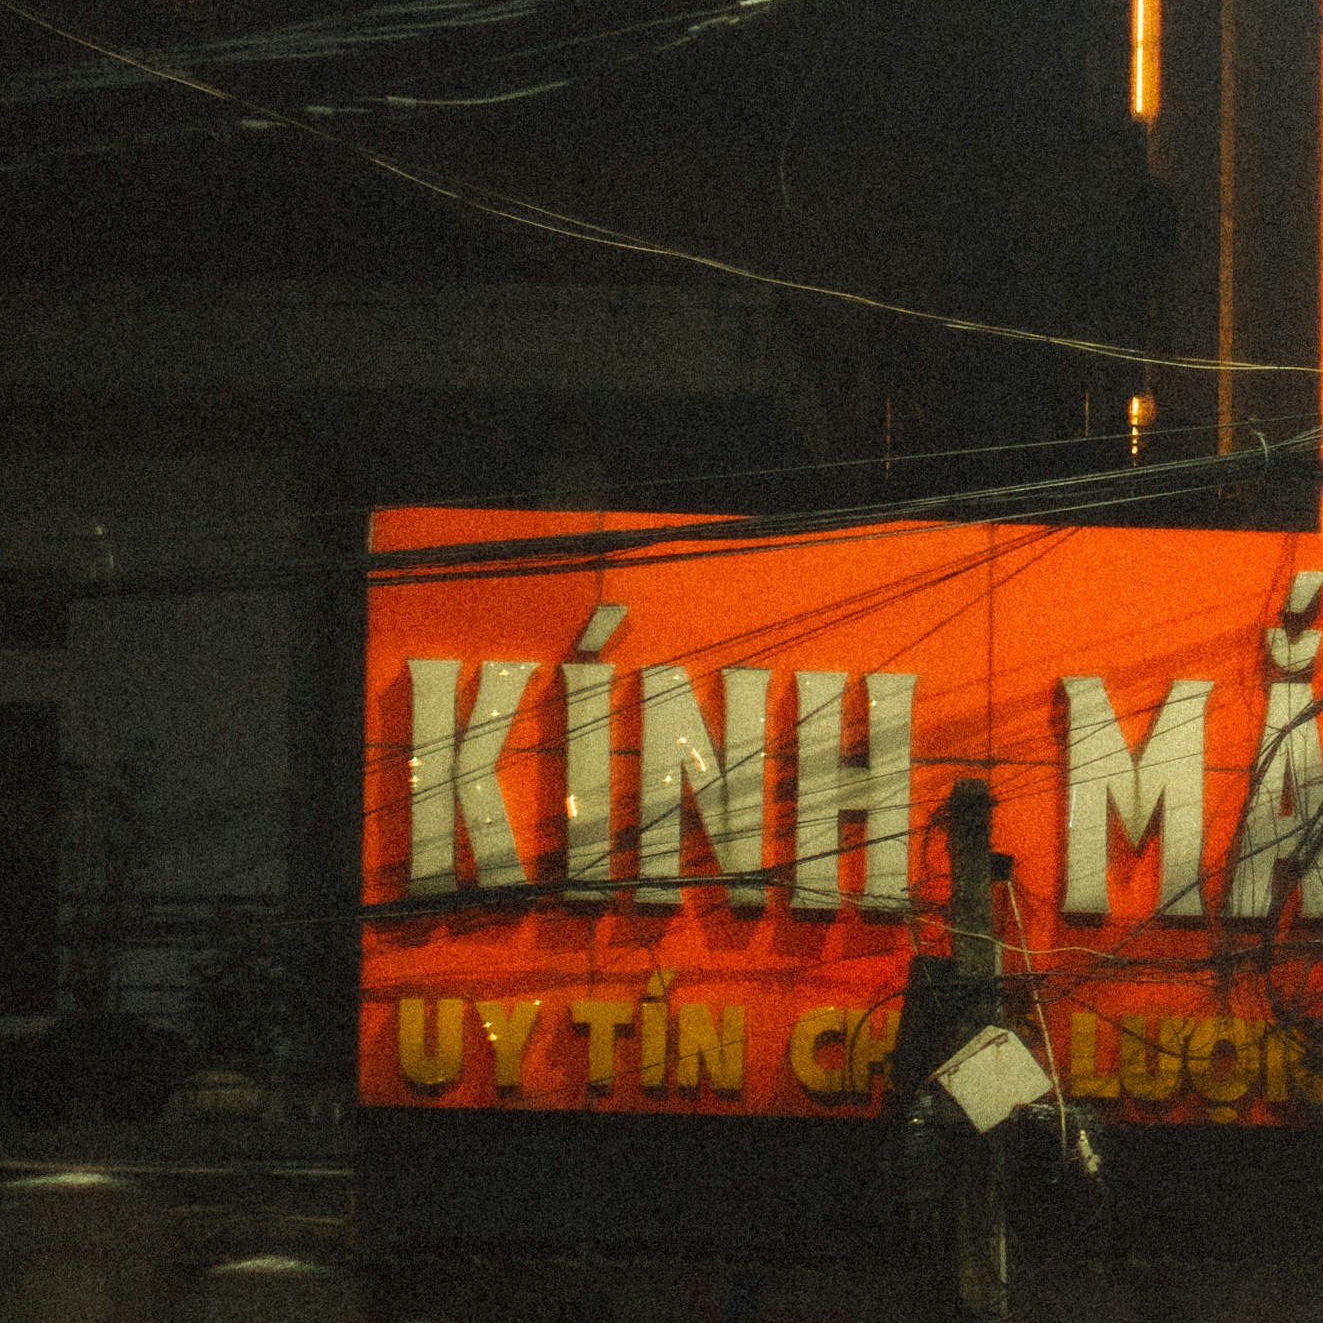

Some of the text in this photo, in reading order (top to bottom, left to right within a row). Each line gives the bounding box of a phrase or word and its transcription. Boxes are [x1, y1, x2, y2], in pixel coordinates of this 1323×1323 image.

[408, 603, 917, 911] KÍNH
[399, 997, 543, 1087] UY
[571, 967, 746, 1090] TÍN
